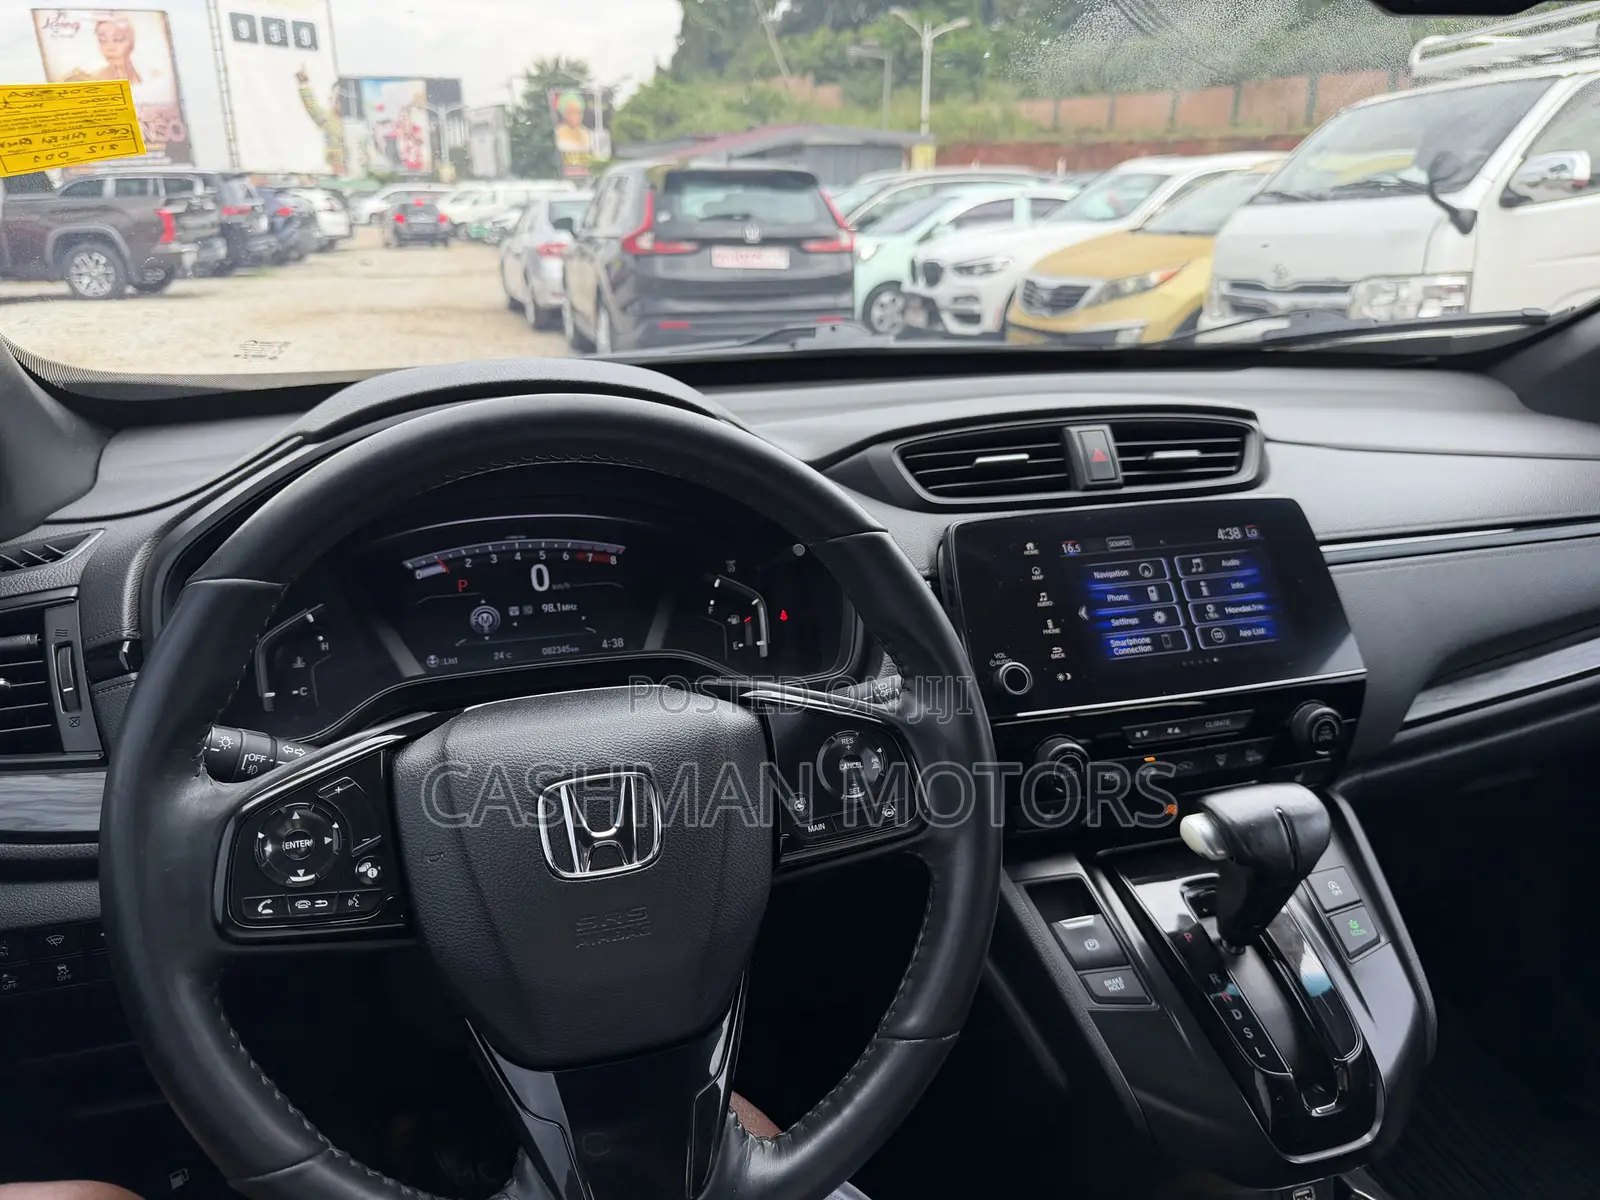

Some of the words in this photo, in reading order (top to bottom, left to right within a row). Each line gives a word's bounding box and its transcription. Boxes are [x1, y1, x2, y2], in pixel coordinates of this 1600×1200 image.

[1217, 527, 1241, 540] 4:38
[1061, 543, 1081, 554] 16.5
[465, 558, 472, 568] 2
[490, 554, 498, 564] 3
[514, 552, 521, 561] 4
[539, 550, 546, 560] 5
[562, 552, 570, 561] 6
[586, 553, 594, 562] 7
[610, 555, 617, 565] 8
[1221, 559, 1240, 567] Audio
[530, 563, 550, 592] 0
[1093, 569, 1129, 579] Navigation
[457, 579, 468, 592] P
[1230, 581, 1244, 589] Info
[1106, 593, 1129, 602] Phone
[1111, 616, 1140, 627] Settings
[1239, 629, 1252, 638] App
[1252, 627, 1266, 636] List
[320, 642, 330, 651] H
[602, 638, 624, 648] 4:38
[1110, 636, 1151, 648] Smartphone
[1113, 645, 1152, 656] Connection
[299, 687, 308, 696] C
[249, 754, 267, 763] OFF
[839, 762, 864, 771] CANCEL
[848, 787, 861, 795] SET
[807, 823, 826, 833] MAIN
[285, 840, 311, 850] ENTER
[1184, 932, 1193, 943] P
[1103, 976, 1125, 986] BRAKE
[1209, 973, 1221, 984] R
[2, 983, 18, 991] OFF
[1108, 983, 1125, 992] HOLD
[1220, 991, 1233, 1003] N
[1230, 1009, 1243, 1020] D
[1243, 1027, 1254, 1039] S
[1254, 1047, 1266, 1059] L
